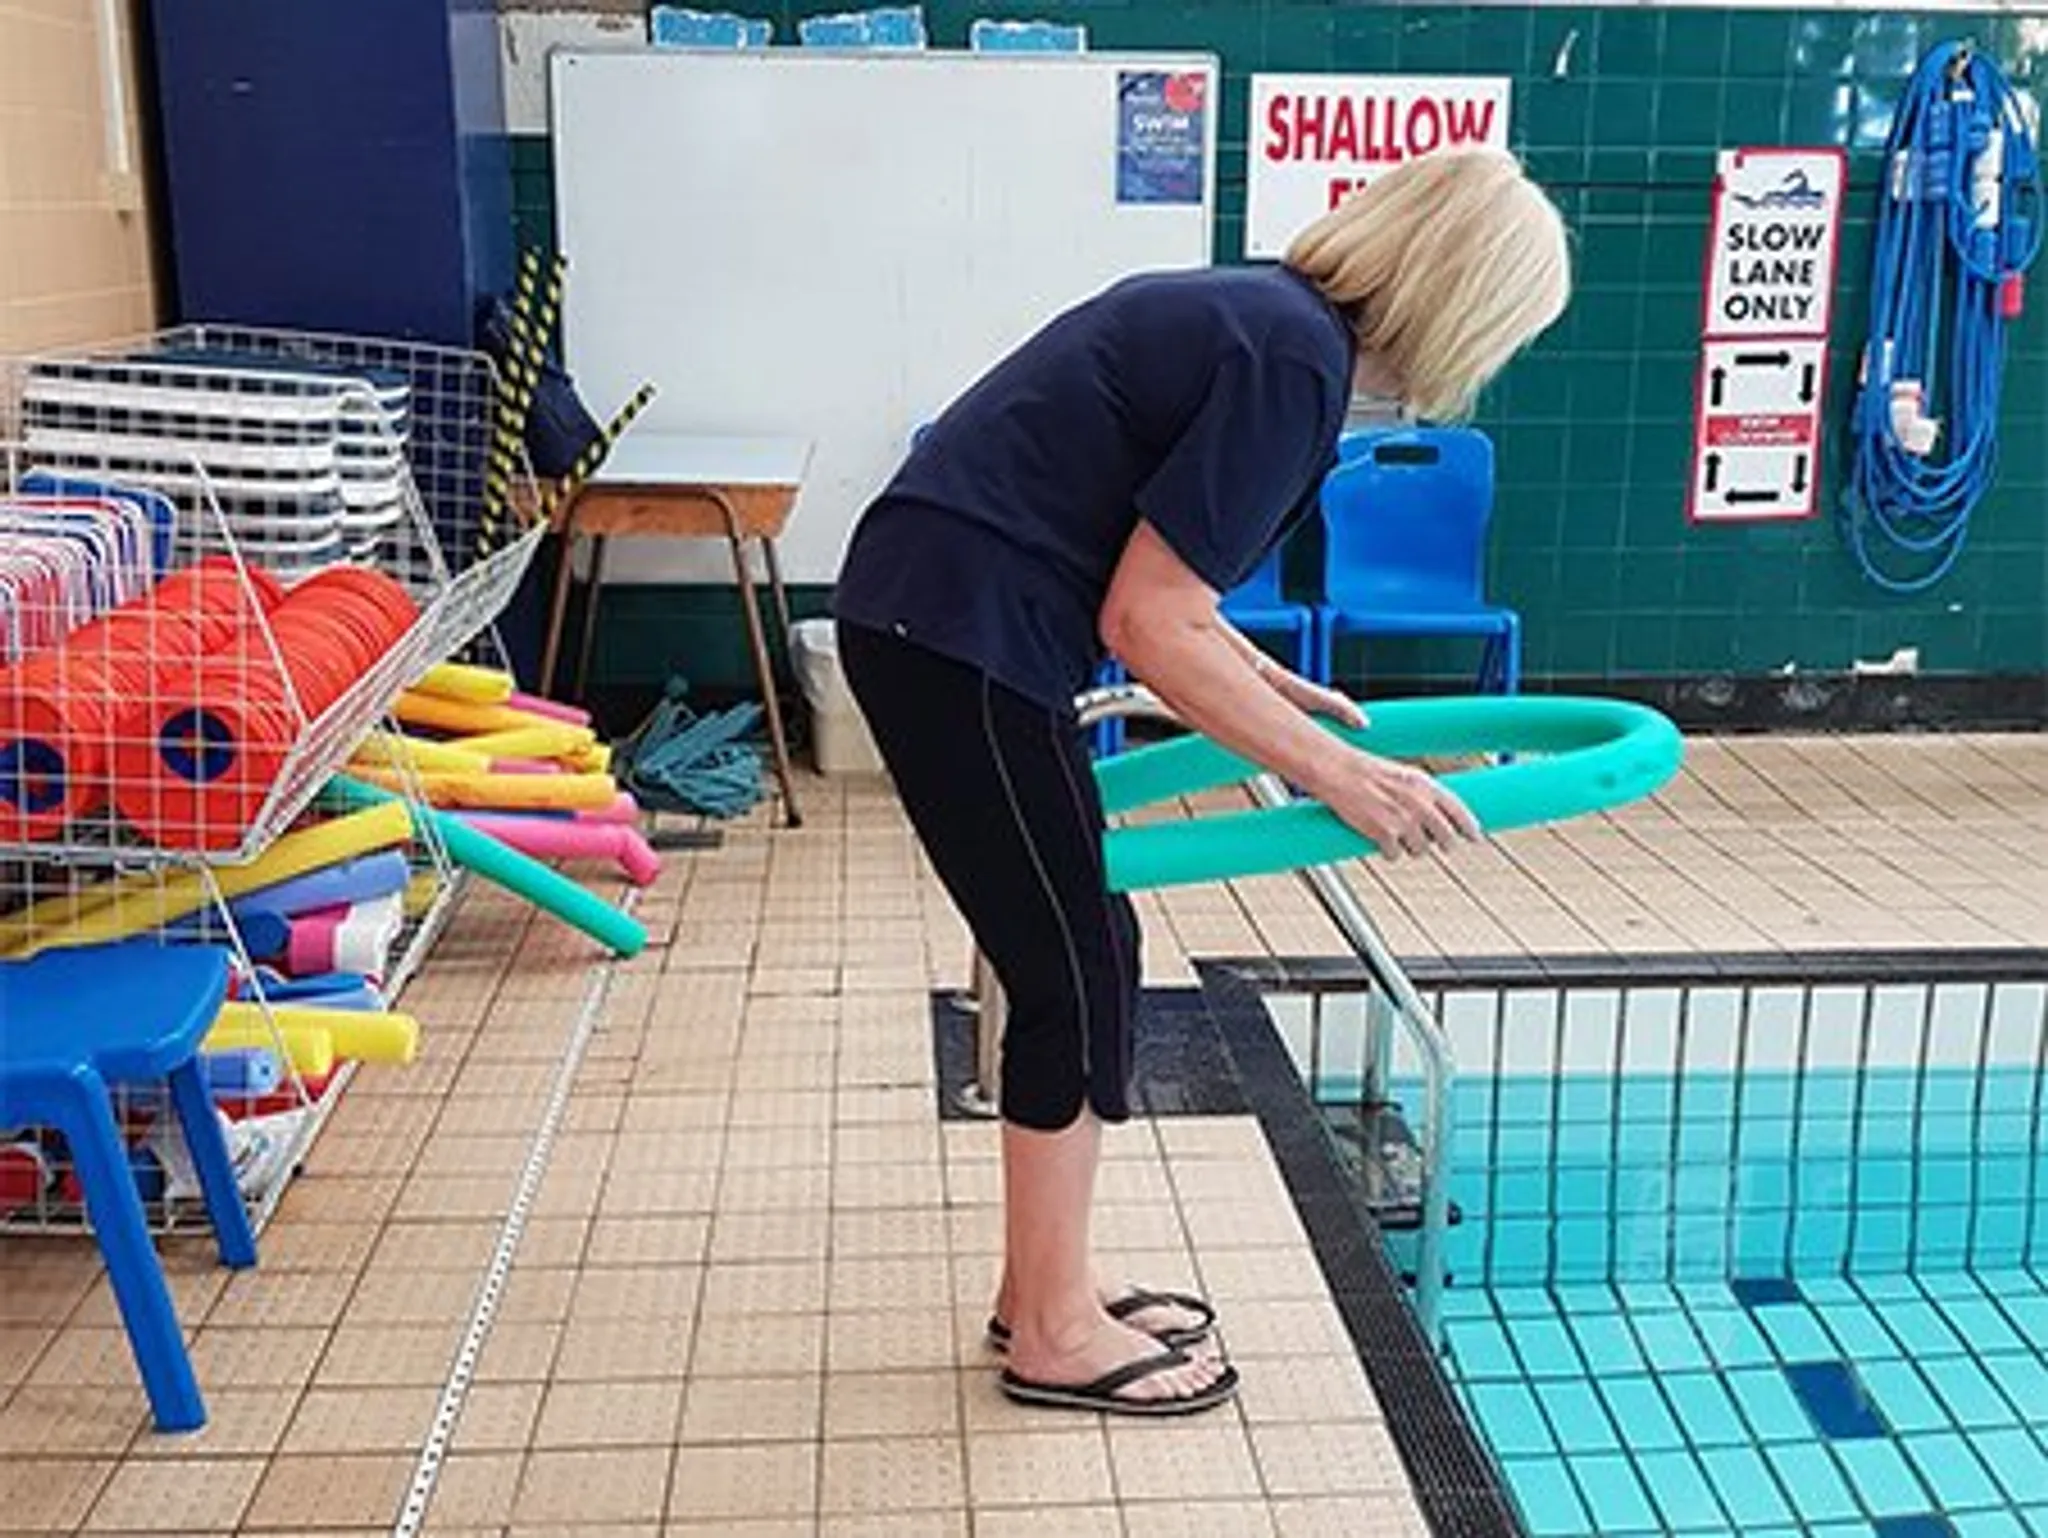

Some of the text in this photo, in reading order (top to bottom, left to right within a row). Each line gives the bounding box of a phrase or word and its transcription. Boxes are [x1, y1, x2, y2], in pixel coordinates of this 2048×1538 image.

[1265, 95, 1494, 161] SHALLOW
[1727, 222, 1826, 252] SLOW
[1730, 259, 1814, 287] LANE
[1724, 293, 1813, 321] ONLY
